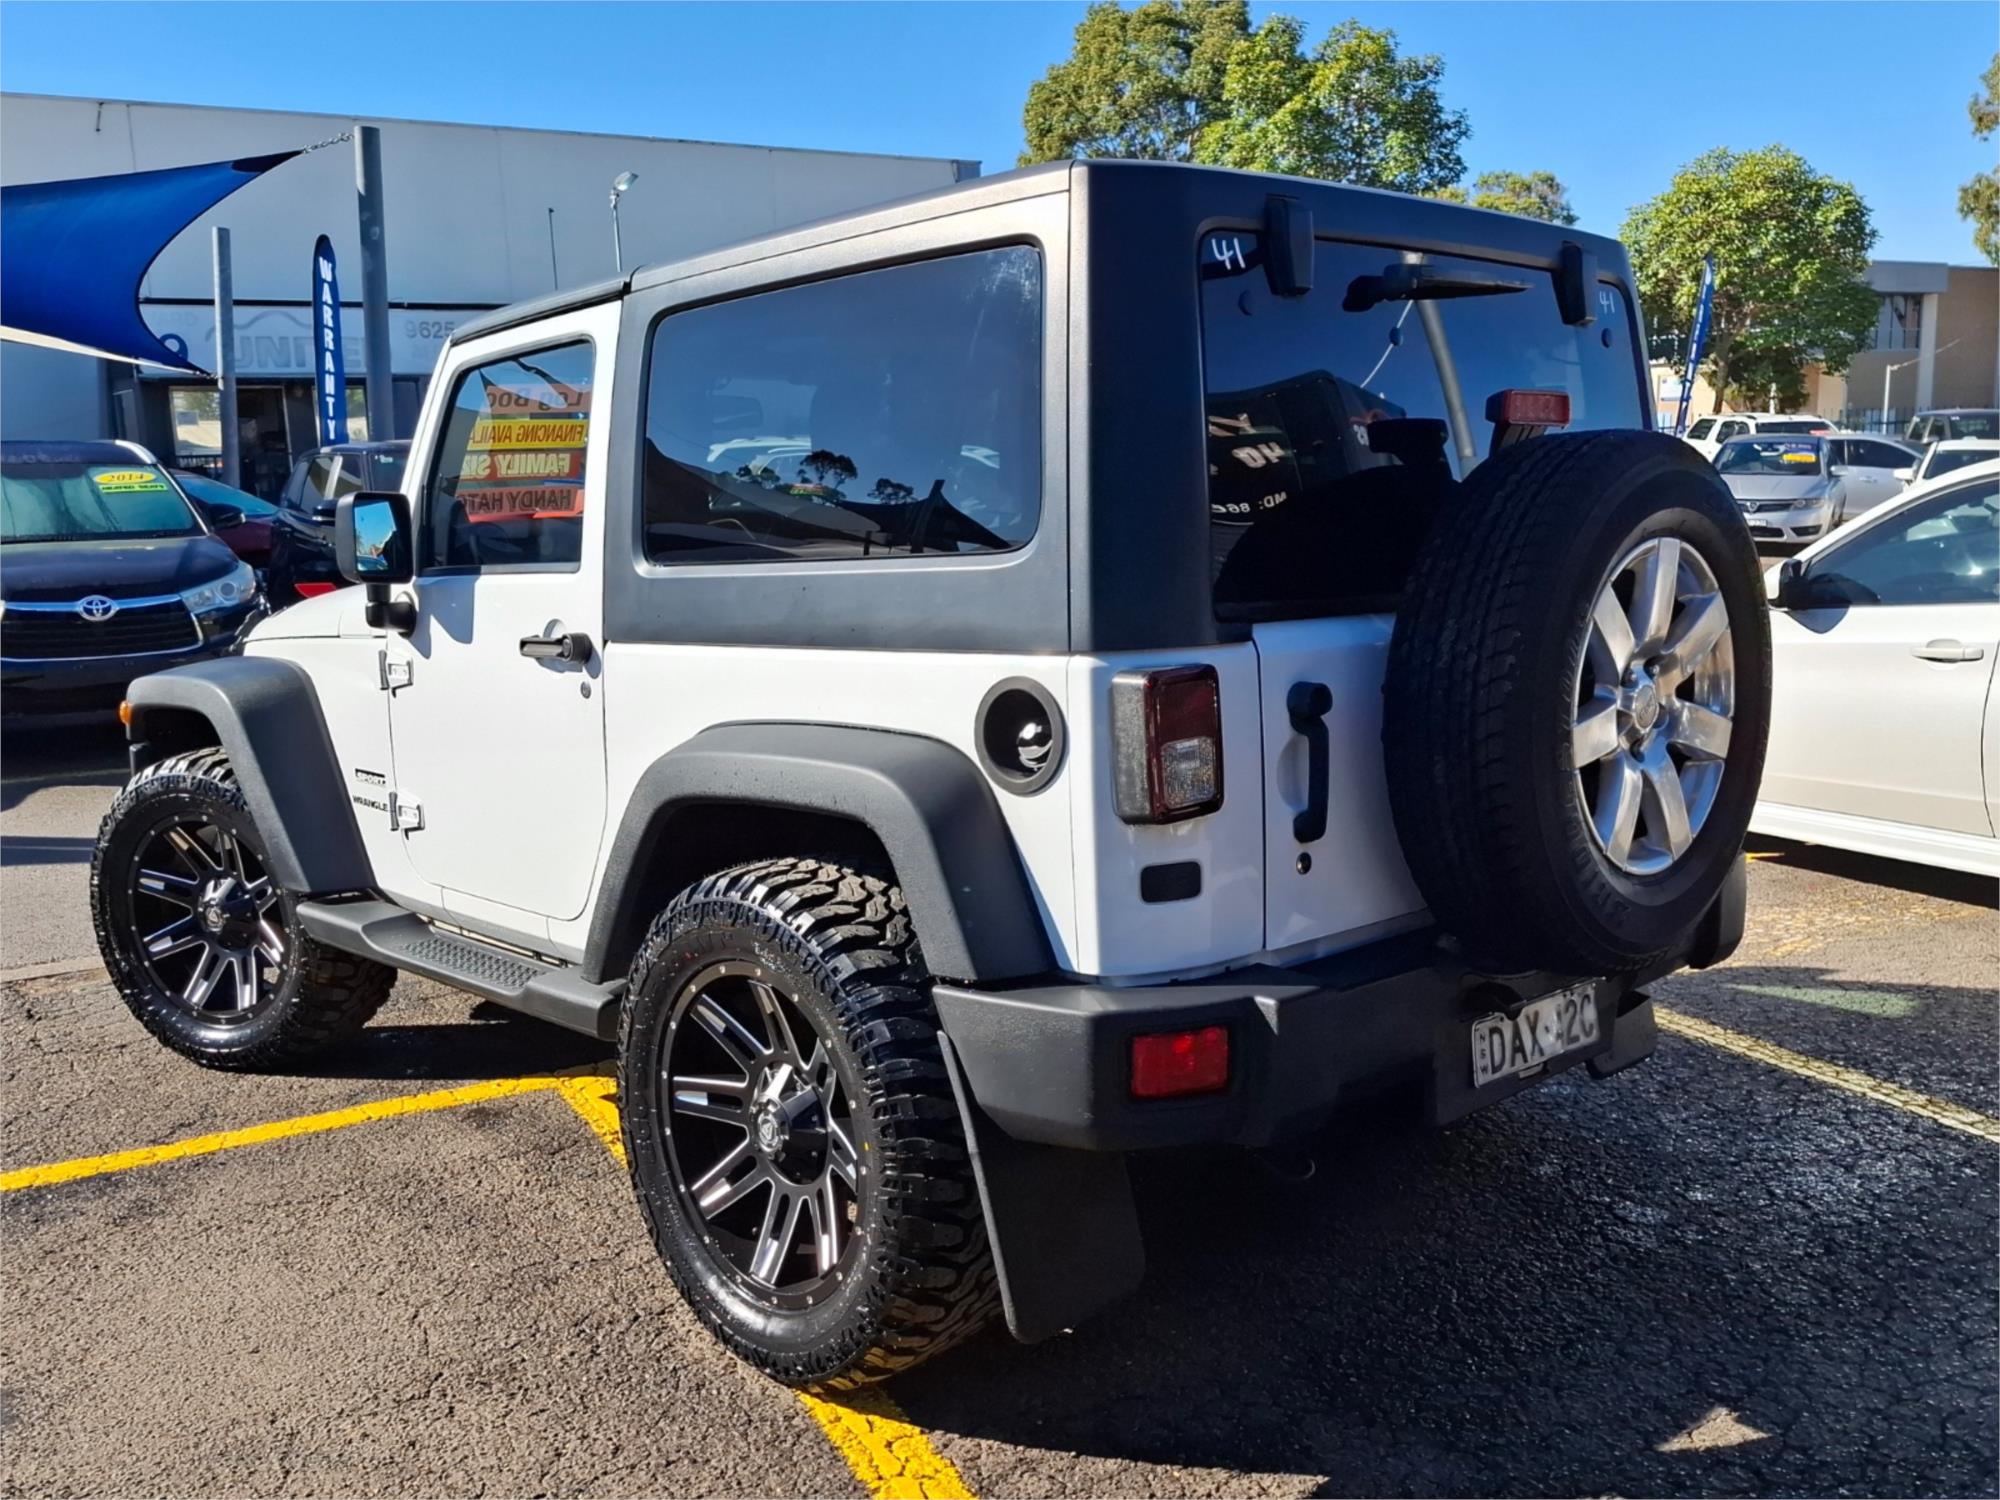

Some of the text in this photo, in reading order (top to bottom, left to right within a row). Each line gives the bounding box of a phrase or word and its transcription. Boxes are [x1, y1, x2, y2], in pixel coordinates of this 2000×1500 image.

[1211, 237, 1246, 270] 41
[1599, 290, 1615, 315] 41
[318, 256, 336, 441] WARRANTY
[109, 472, 144, 481] 2014
